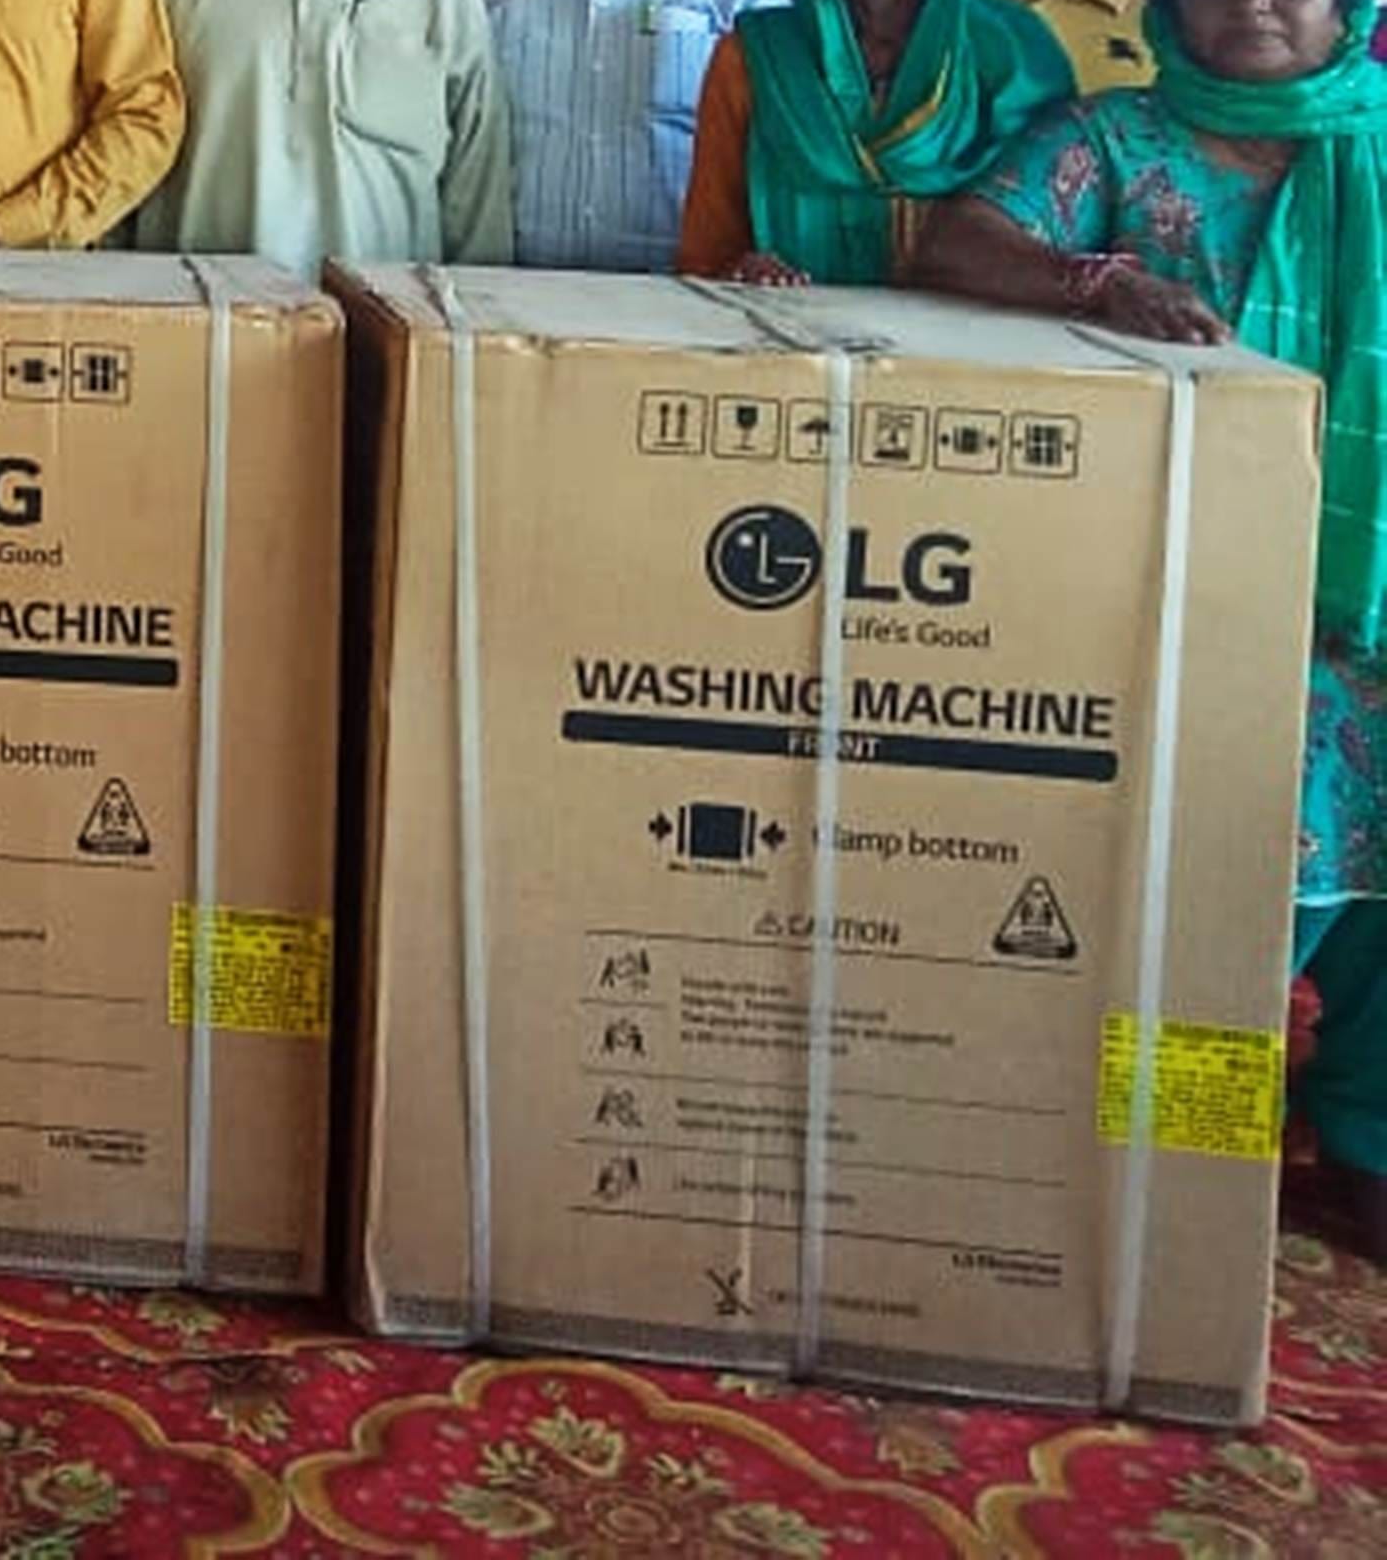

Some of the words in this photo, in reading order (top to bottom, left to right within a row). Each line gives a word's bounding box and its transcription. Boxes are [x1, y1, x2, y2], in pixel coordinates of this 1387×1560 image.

[844, 527, 973, 607] LG
[840, 616, 910, 646] Life's
[915, 620, 993, 650] Good
[573, 657, 827, 719] WASHING
[852, 678, 1118, 739] MACHINE
[0, 736, 98, 768] bottom
[786, 730, 883, 761] FRNT
[908, 828, 1020, 865] bottom
